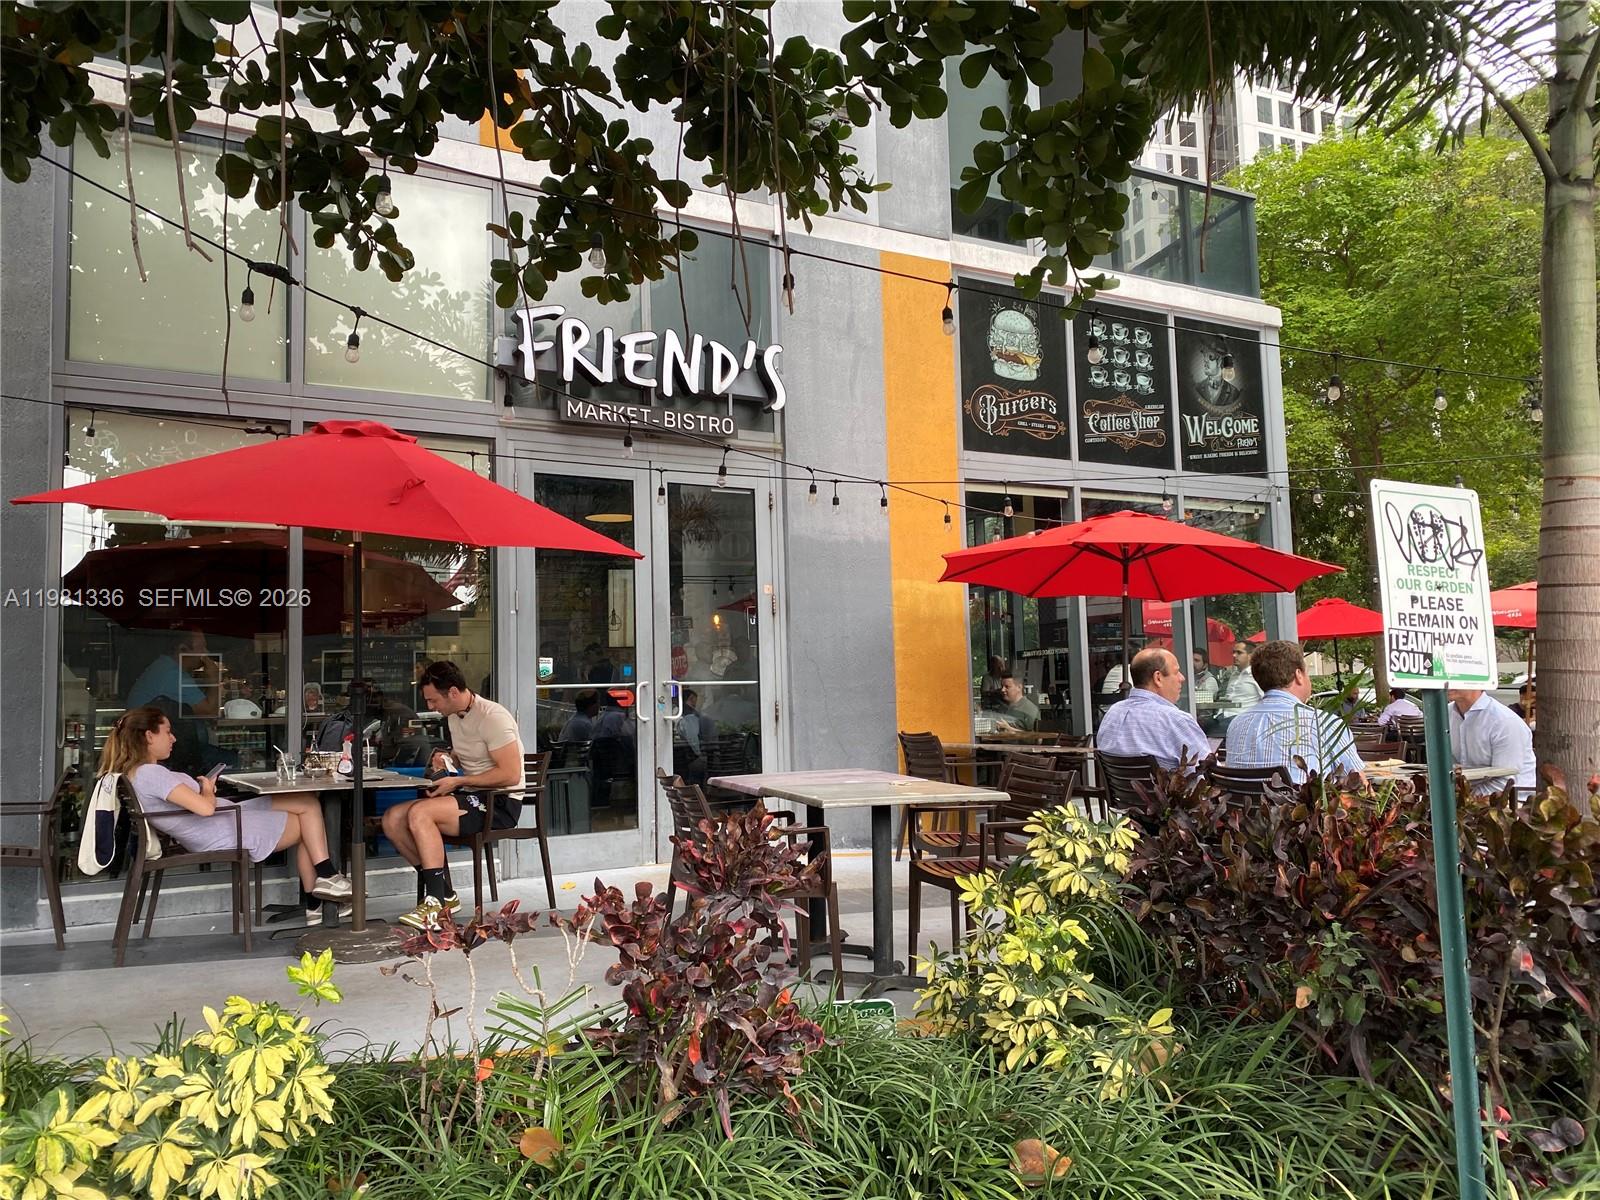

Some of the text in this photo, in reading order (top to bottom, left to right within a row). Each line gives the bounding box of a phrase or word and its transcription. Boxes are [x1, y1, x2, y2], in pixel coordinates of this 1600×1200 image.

[515, 304, 787, 412] FRIEND'S
[1088, 411, 1131, 435] Coffee
[1407, 564, 1460, 579] RESPECT
[1396, 577, 1474, 594] OUR GARDEN
[1410, 595, 1465, 612] PLEASE
[1398, 612, 1479, 631] REMAIN ON
[1389, 629, 1433, 654] TEAM
[1432, 632, 1474, 646] HWAY
[1390, 650, 1429, 675] SOUL
